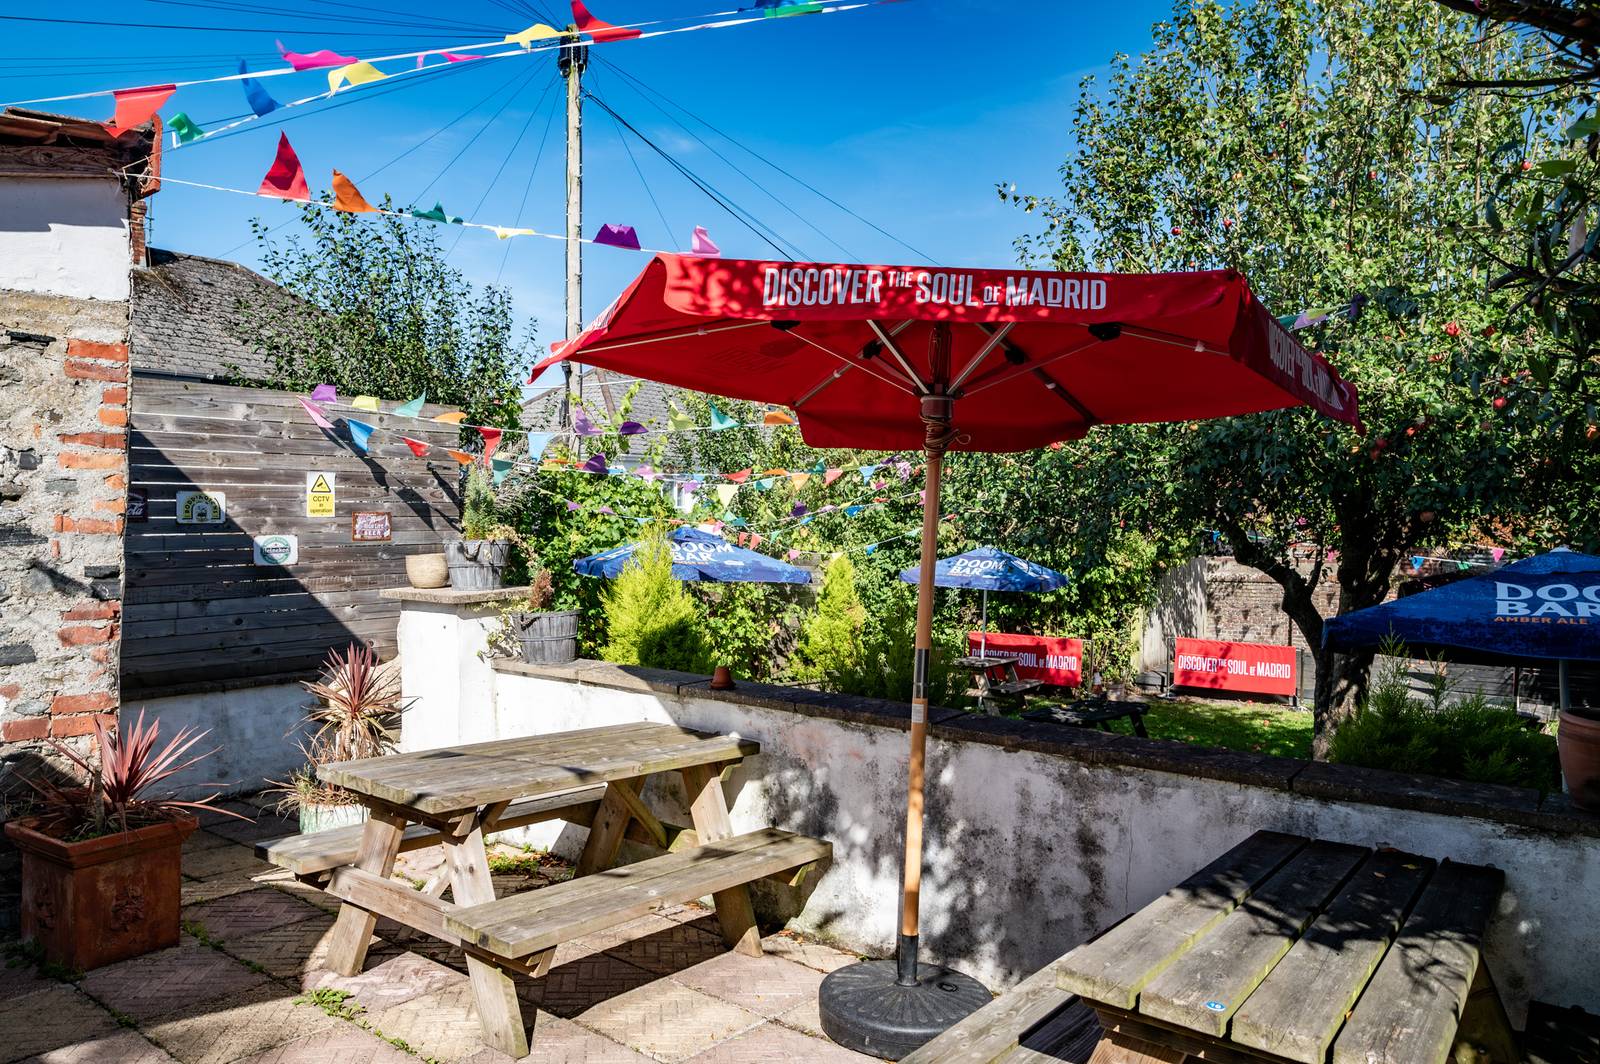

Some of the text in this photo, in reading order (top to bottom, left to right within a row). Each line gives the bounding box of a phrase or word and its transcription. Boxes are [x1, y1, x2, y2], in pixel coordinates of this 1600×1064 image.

[763, 267, 1107, 310] DISCOVER THE SOUL OF MADRID
[670, 551, 716, 561] BAR
[956, 558, 1006, 570] DOOM
[949, 566, 982, 576] BAR
[1556, 617, 1588, 625] ALE
[1018, 652, 1038, 668] SOUL
[1045, 654, 1077, 671] MADRID
[1178, 654, 1291, 679] DISCOVER THE SOUL OF MADRID
